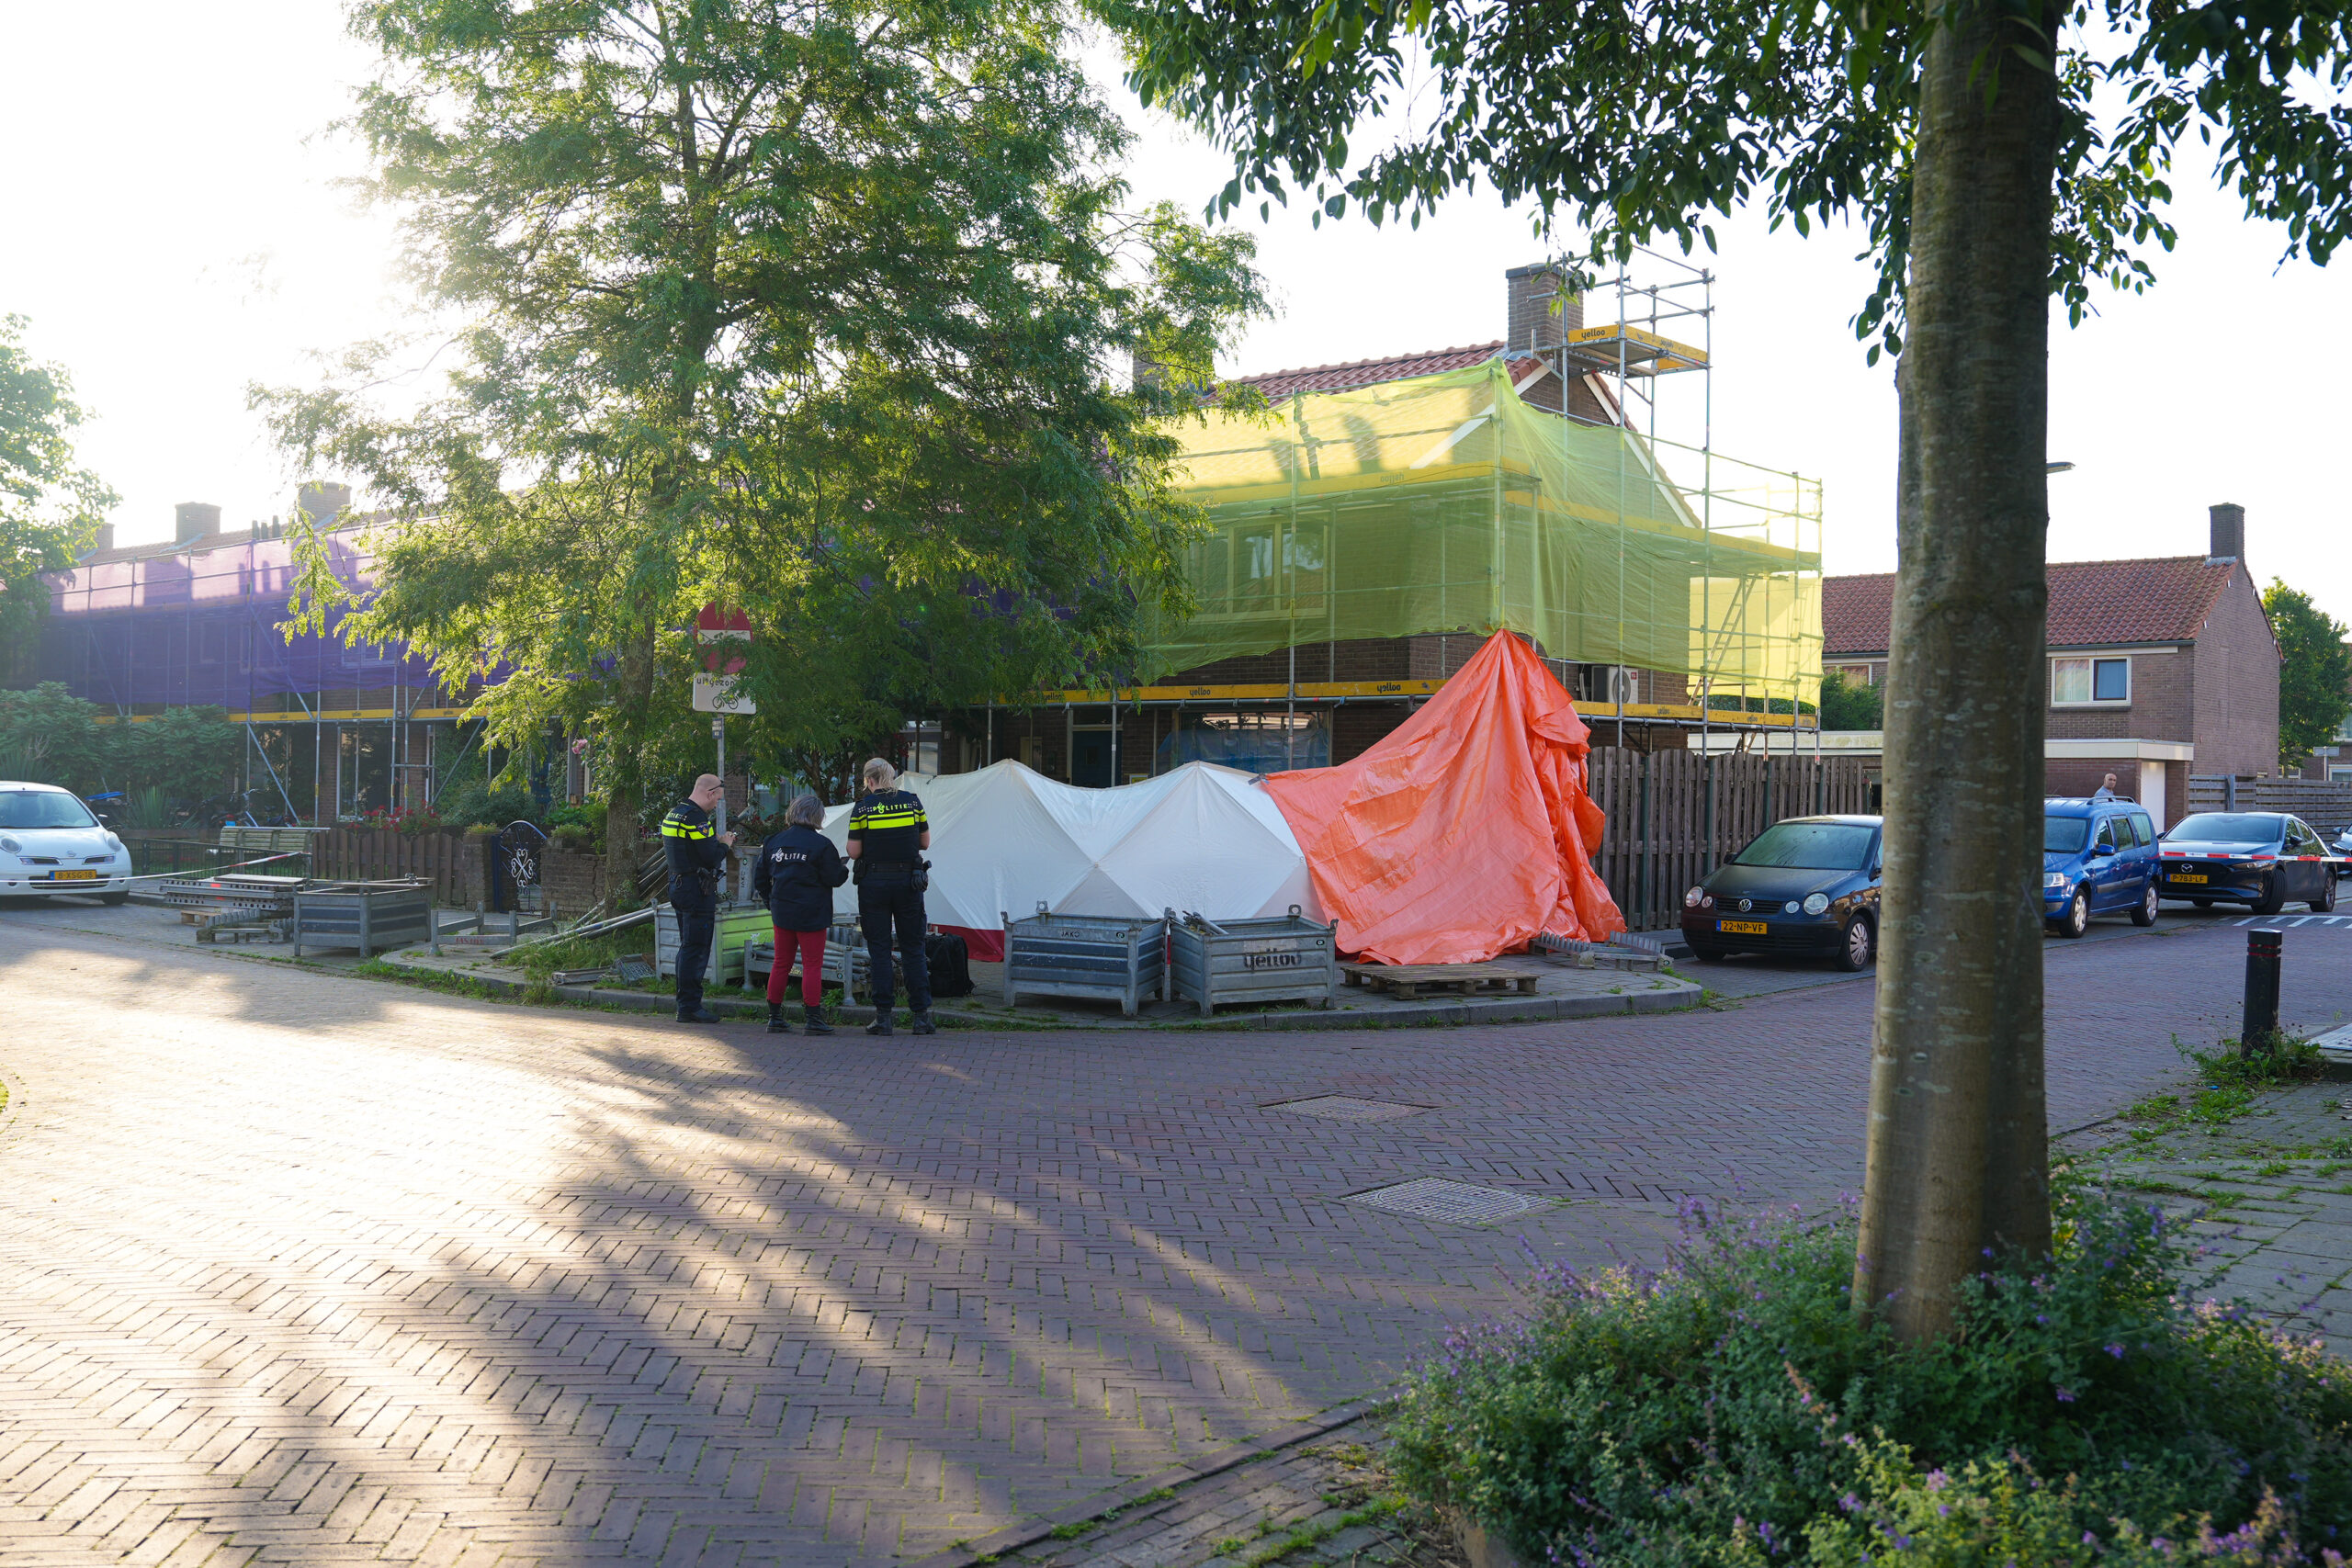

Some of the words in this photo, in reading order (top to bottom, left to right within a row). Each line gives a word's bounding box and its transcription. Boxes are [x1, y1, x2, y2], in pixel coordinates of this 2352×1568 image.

[1581, 328, 1606, 340] yelloo
[1189, 686, 1211, 698] yelloo
[1376, 682, 1401, 694] yelloo
[872, 802, 909, 814] POLITIE
[770, 847, 808, 863] POLITIE
[2172, 874, 2204, 883] P-783-LF
[1723, 921, 1764, 933] 22-NP-VF
